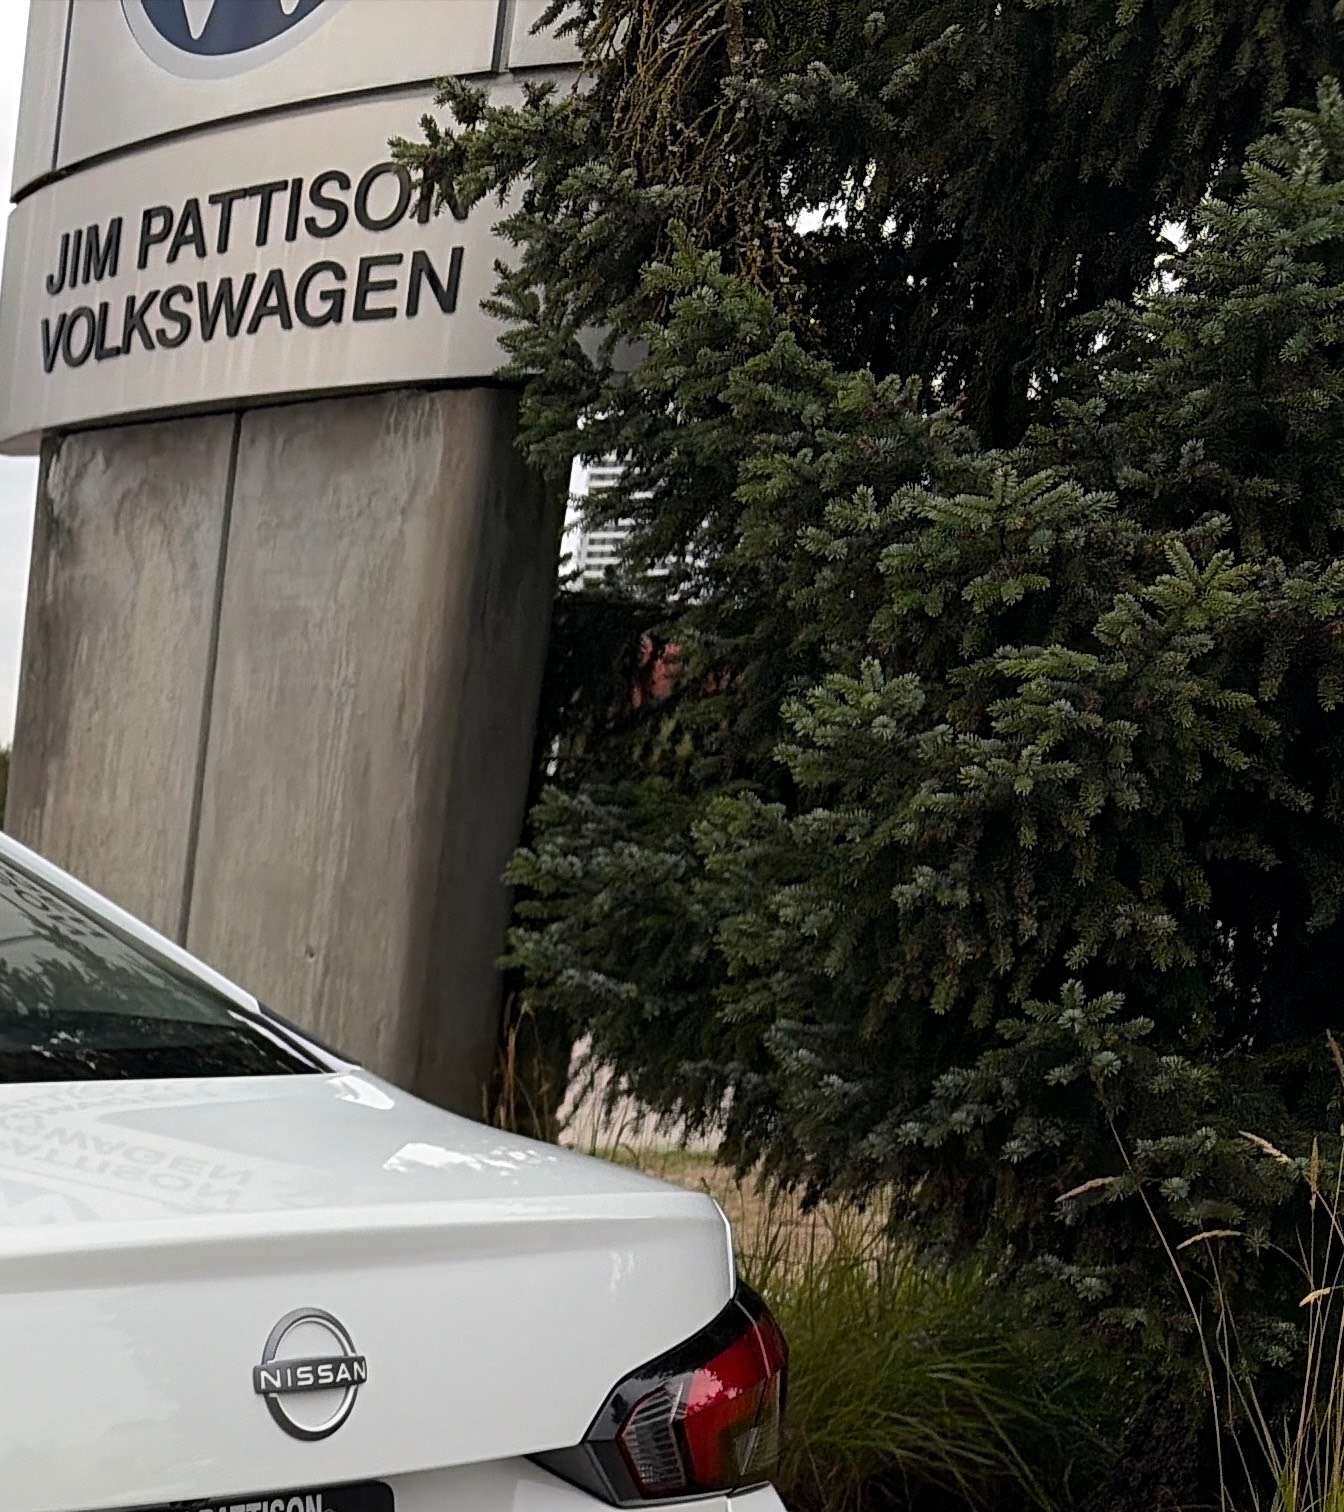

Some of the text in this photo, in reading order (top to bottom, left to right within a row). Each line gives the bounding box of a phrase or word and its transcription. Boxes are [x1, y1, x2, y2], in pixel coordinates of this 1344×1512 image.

[46, 215, 123, 296] JIM
[40, 246, 465, 374] VOLKSWAGEN
[260, 1361, 366, 1390] NISSAN
